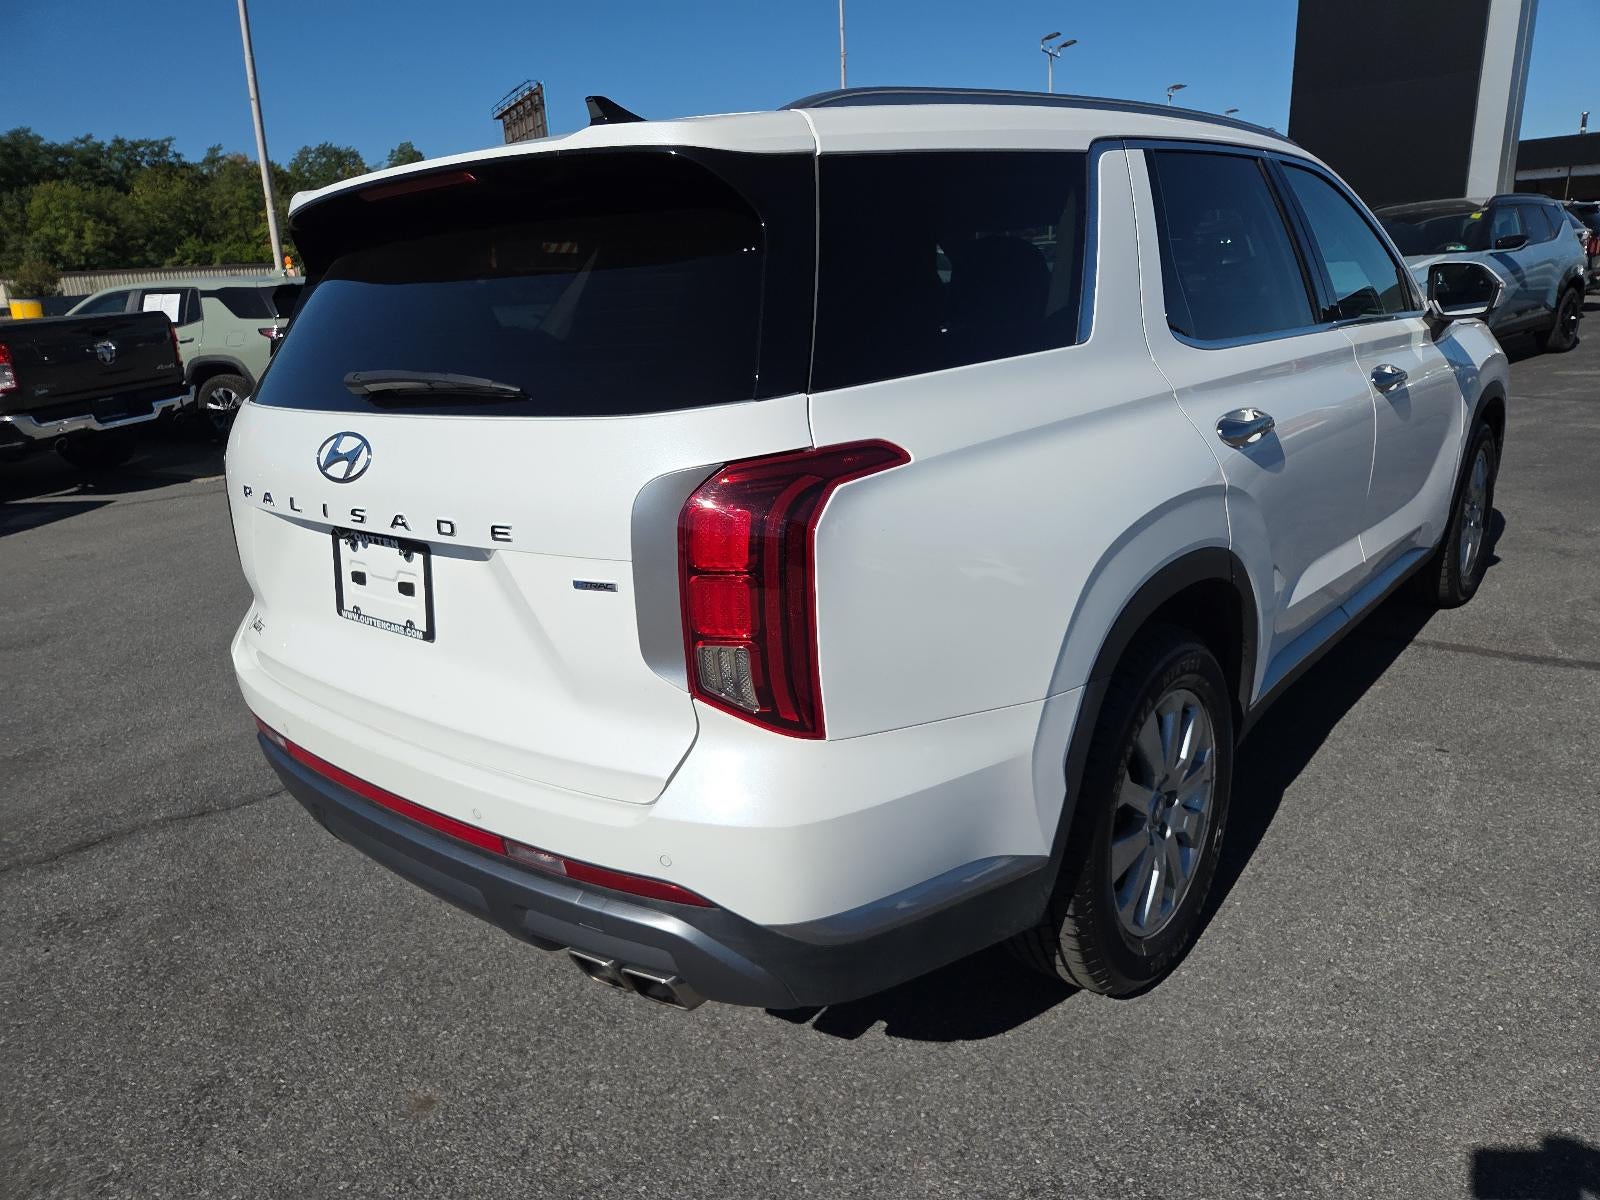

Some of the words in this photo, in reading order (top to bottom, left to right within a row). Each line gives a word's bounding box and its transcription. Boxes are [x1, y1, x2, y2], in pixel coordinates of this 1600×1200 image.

[243, 485, 513, 542] PALISADE
[353, 531, 399, 549] OUTTEN
[341, 608, 424, 641] WWW.OUTTENCARS.COM
